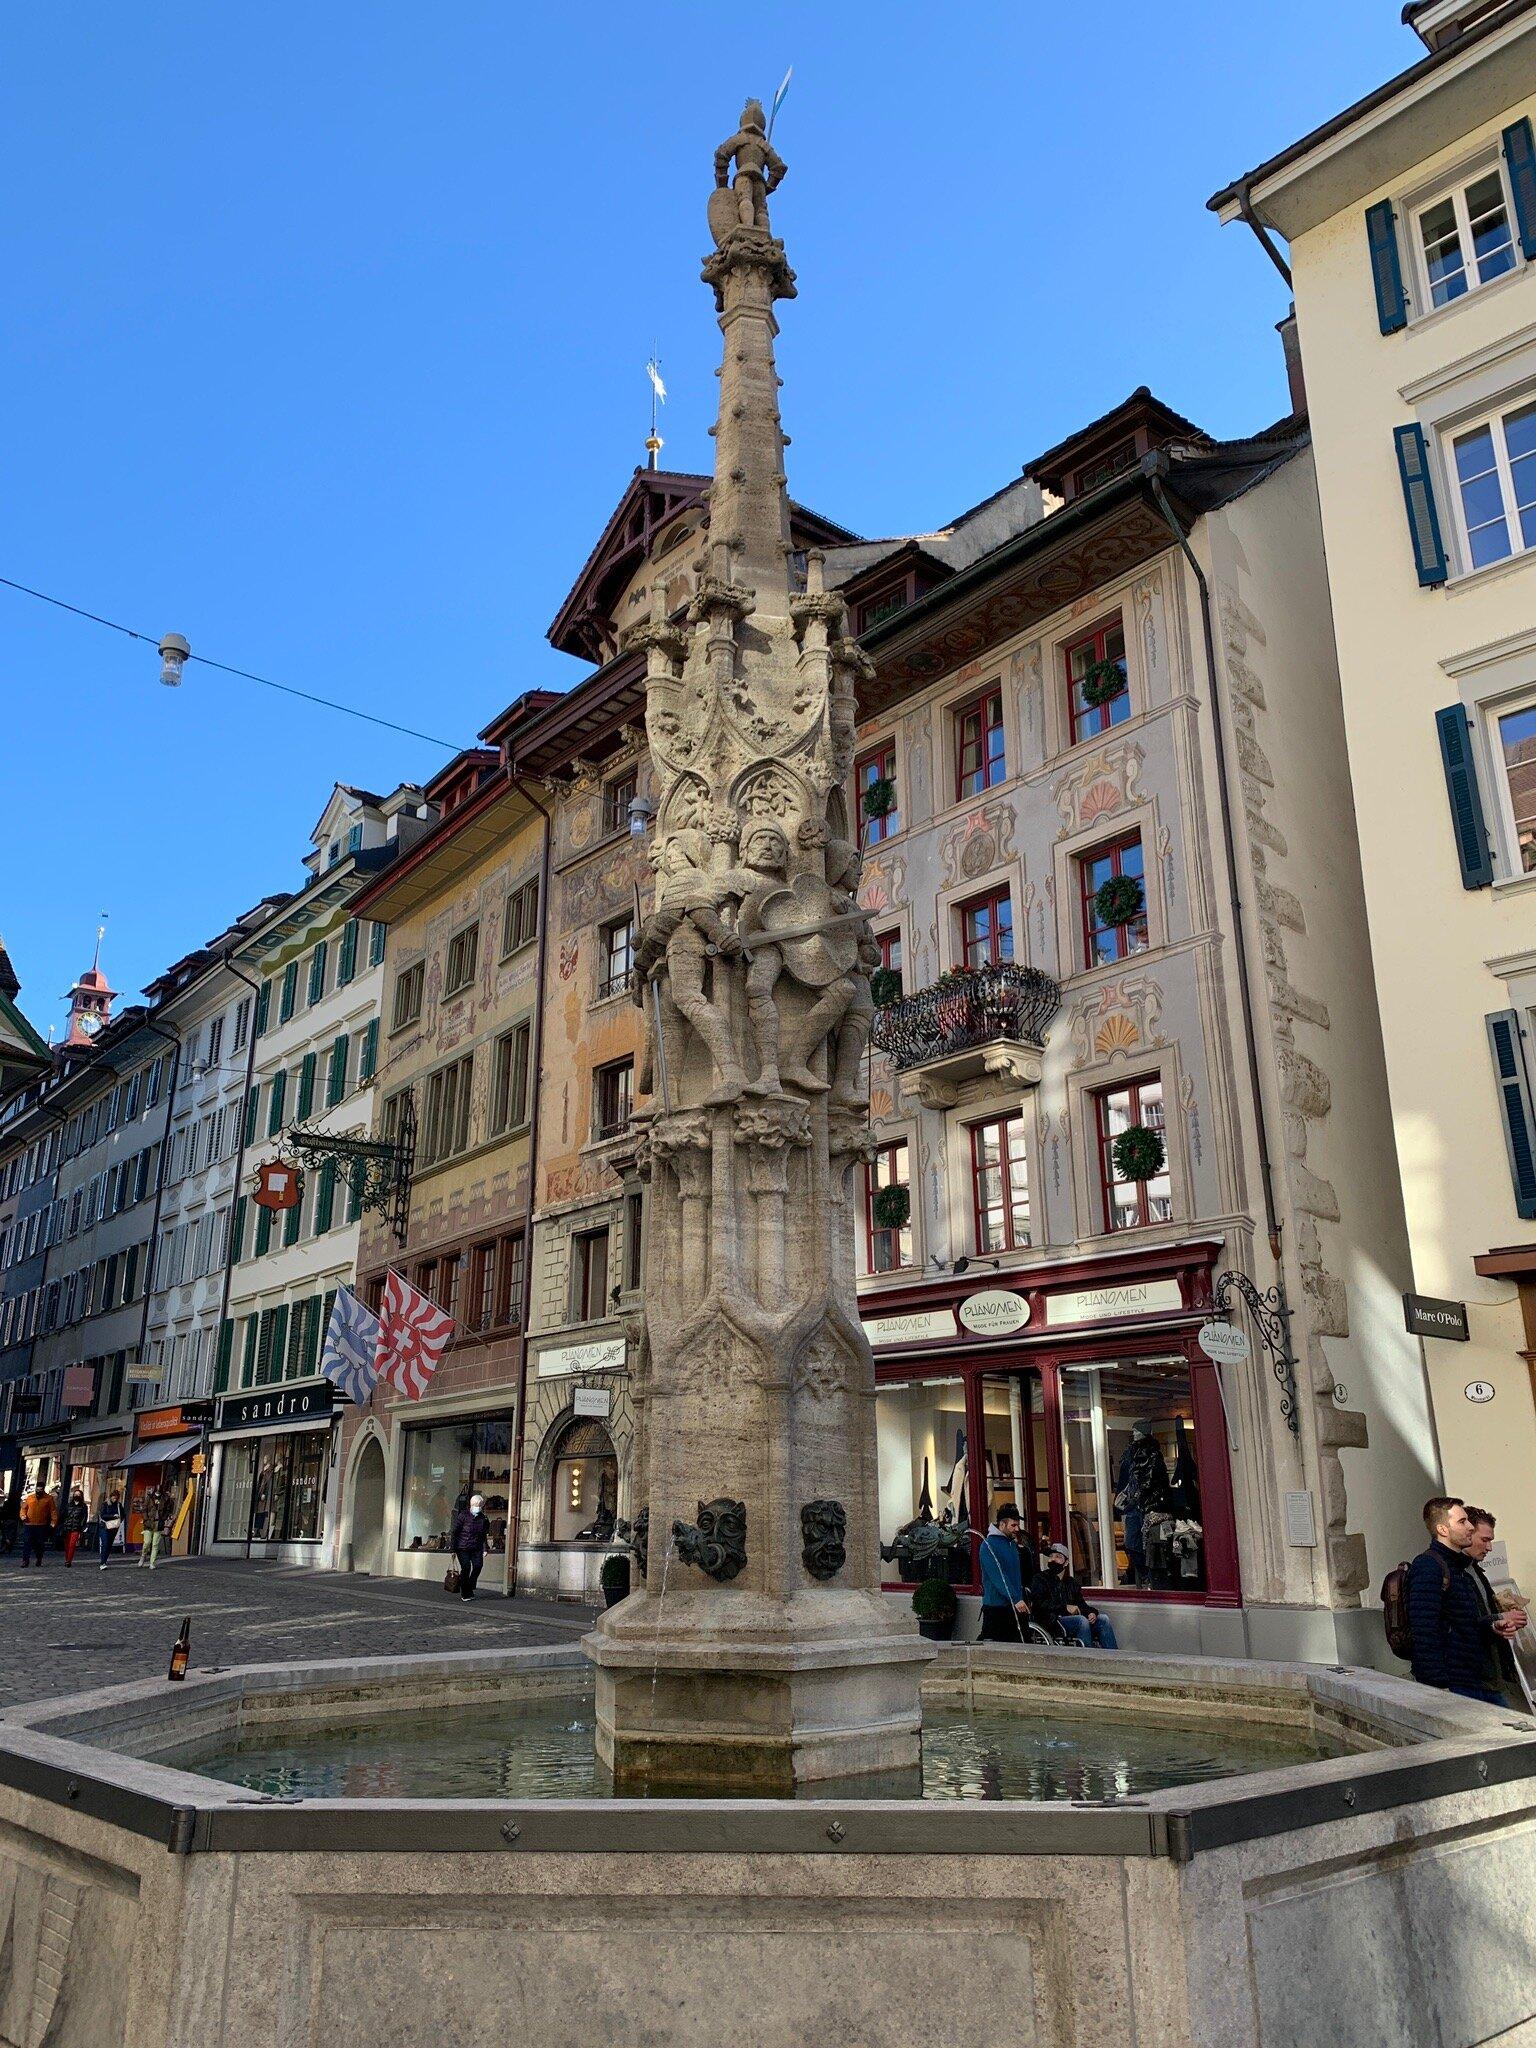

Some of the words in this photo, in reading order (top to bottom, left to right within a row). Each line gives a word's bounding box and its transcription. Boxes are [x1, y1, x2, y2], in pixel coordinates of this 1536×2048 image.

[1415, 1307, 1436, 1322] Marc
[1437, 1312, 1462, 1326] O'Polo
[1475, 1384, 1483, 1395] 6
[241, 1394, 309, 1420] sandro
[292, 1475, 316, 1485] sandro
